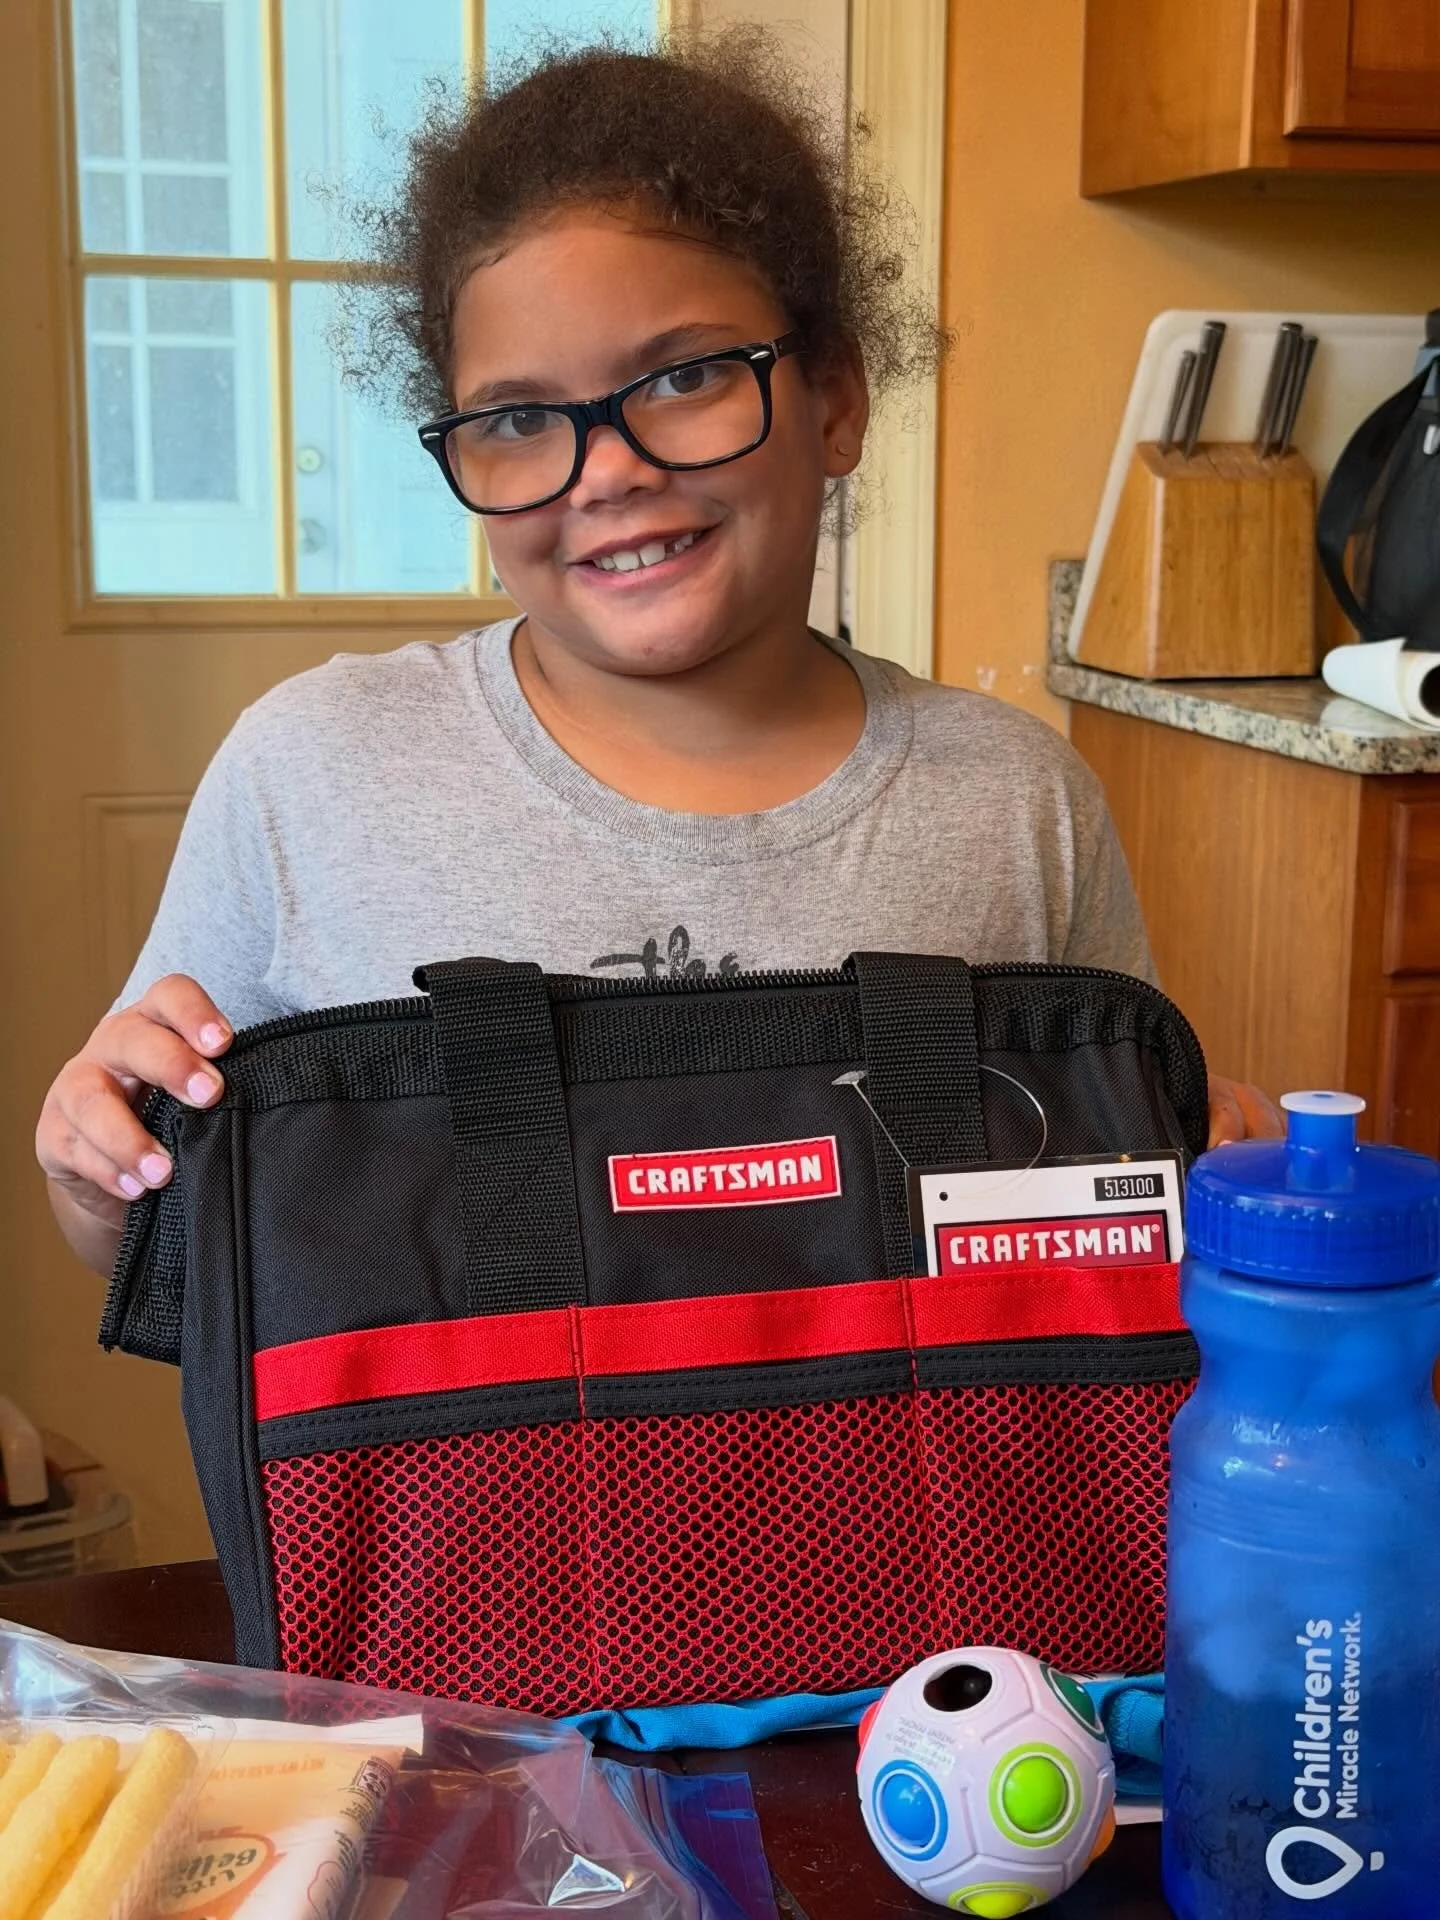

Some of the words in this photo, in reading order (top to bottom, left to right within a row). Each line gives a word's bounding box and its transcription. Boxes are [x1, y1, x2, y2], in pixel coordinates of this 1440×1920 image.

[628, 1154, 822, 1195] CRAFTSMAN
[1104, 1177, 1155, 1198] 513100
[1293, 1618, 1333, 1819] Children's
[1336, 1728, 1360, 1819] Miracle
